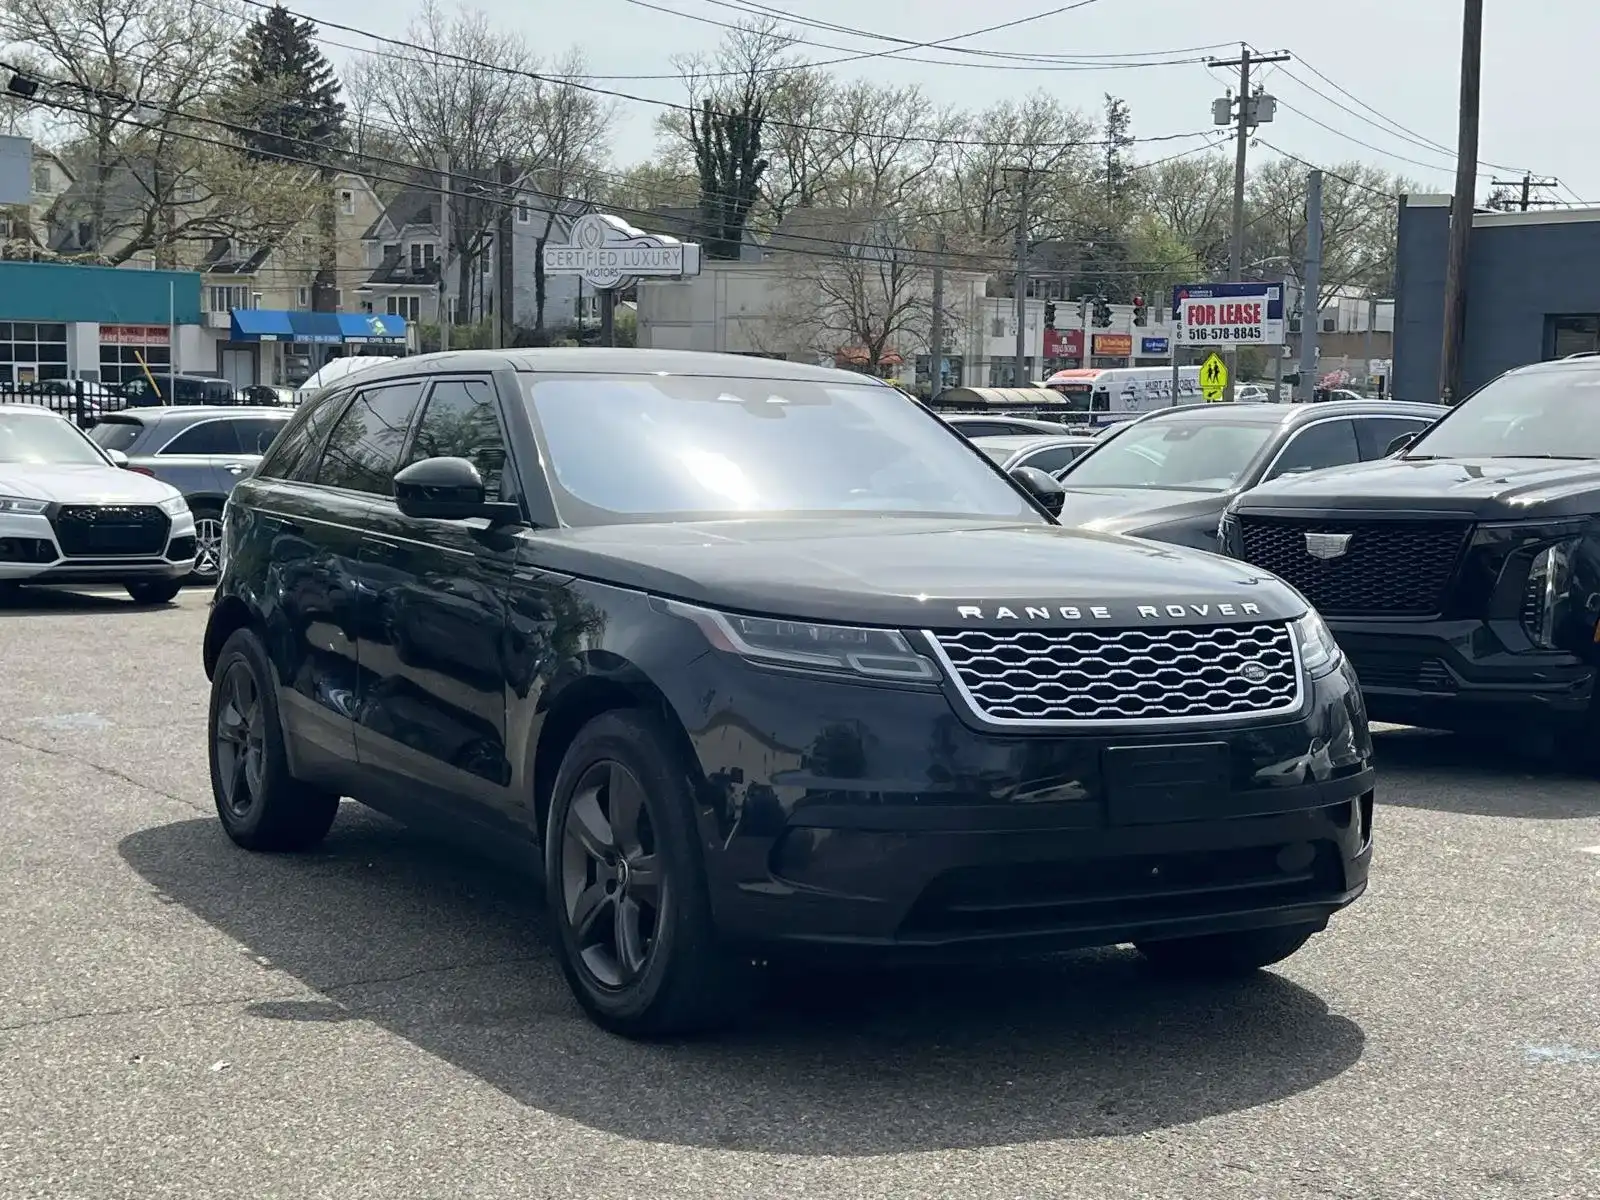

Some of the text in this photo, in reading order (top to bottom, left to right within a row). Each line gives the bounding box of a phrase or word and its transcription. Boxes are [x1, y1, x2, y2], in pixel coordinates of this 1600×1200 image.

[545, 251, 680, 266] CERTIFIED LUXURY
[585, 268, 619, 278] MOTORS
[1187, 303, 1261, 326] FOR LEASE
[1189, 327, 1261, 340] 516-578-8845
[957, 602, 1261, 620] RANGE ROVER
